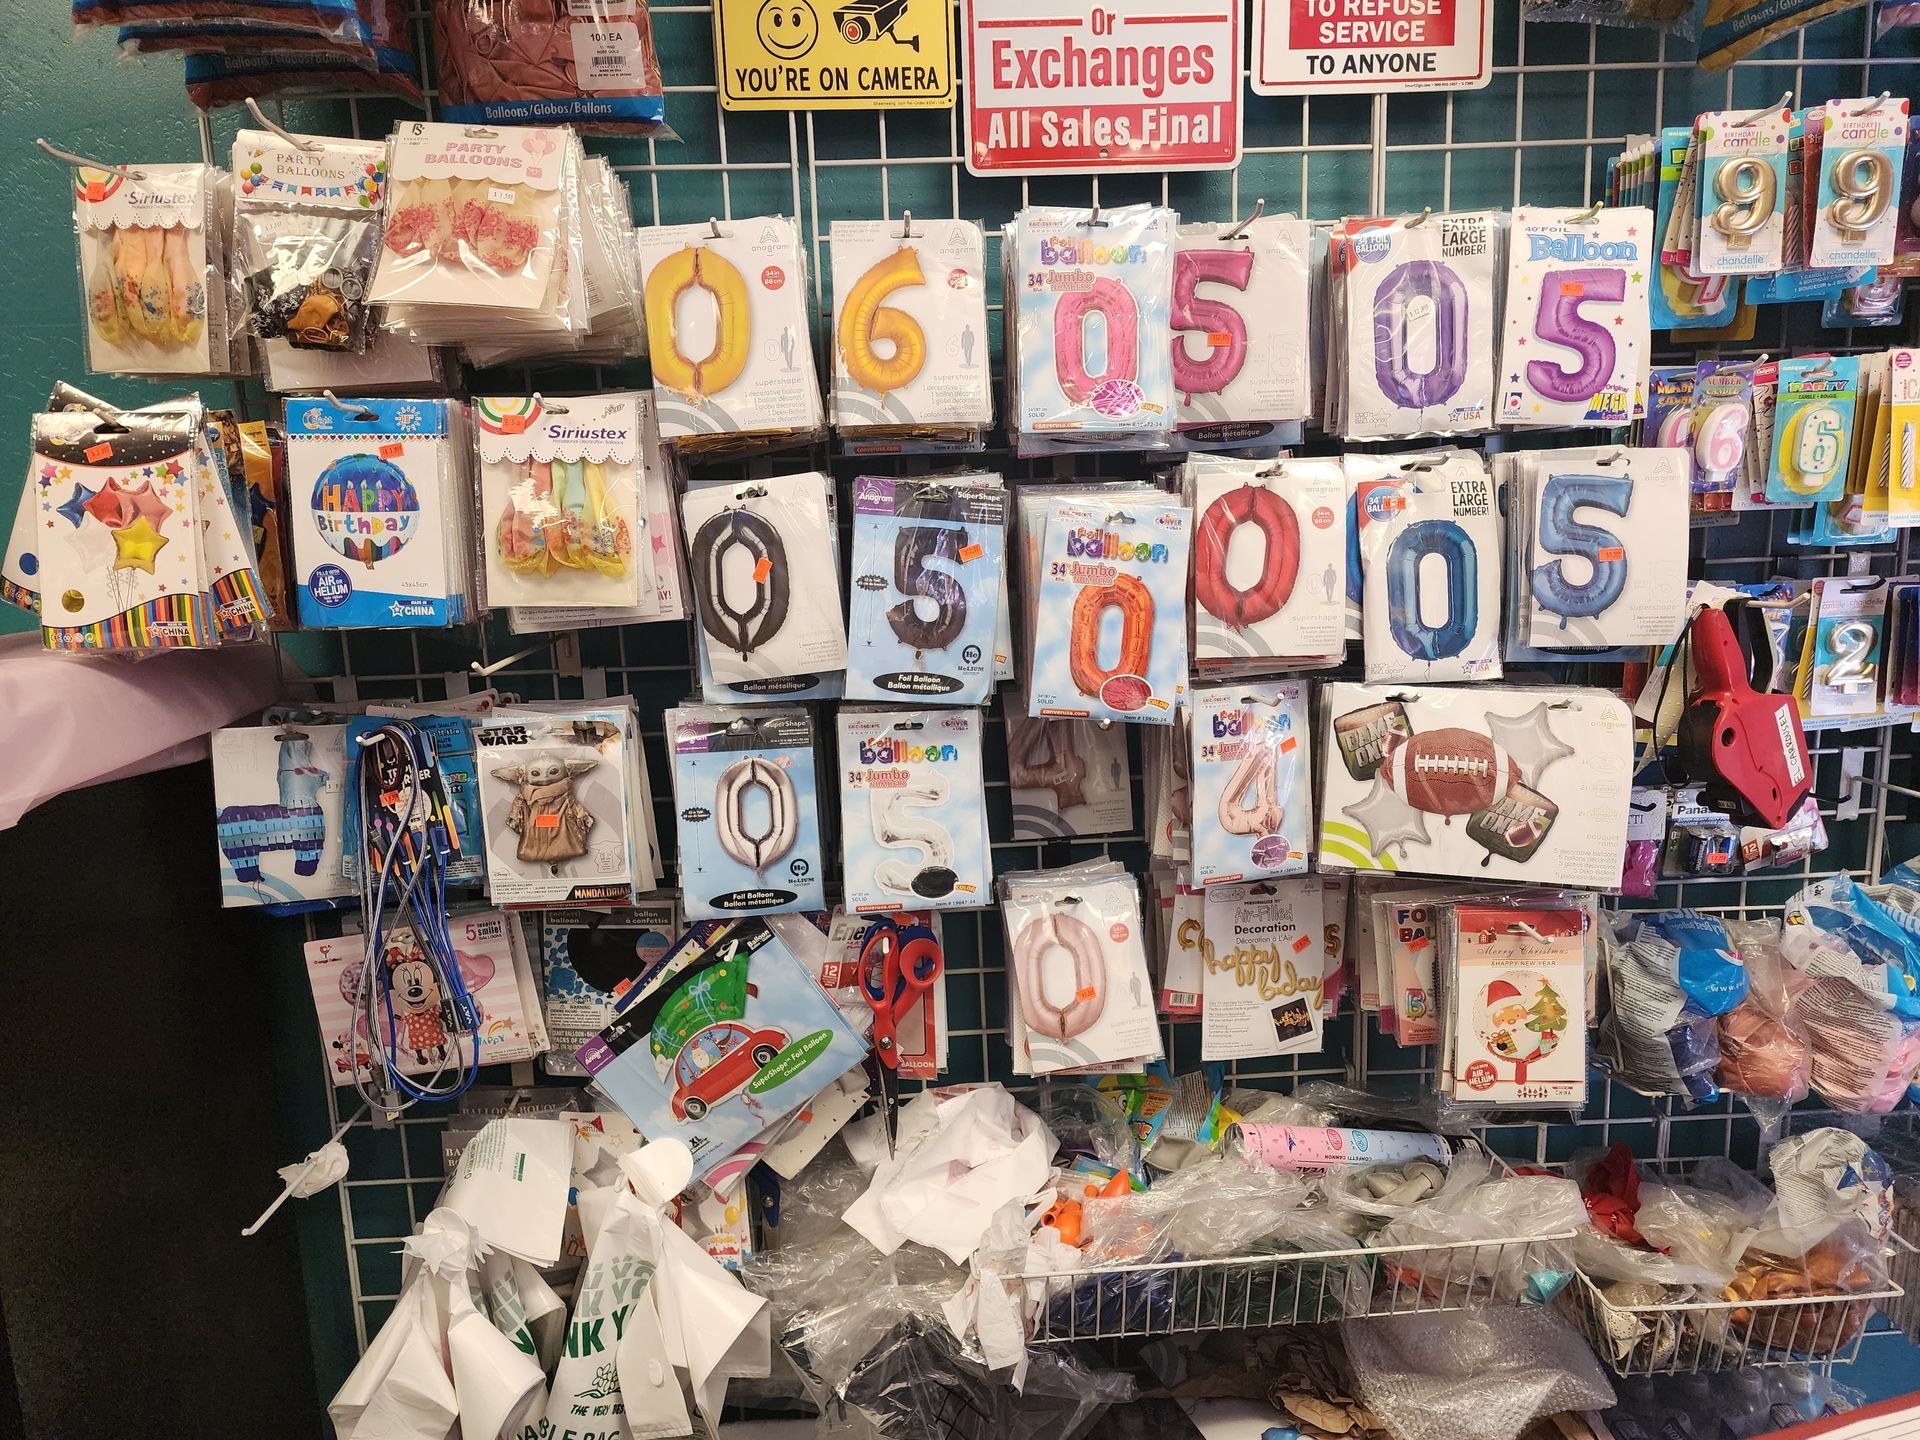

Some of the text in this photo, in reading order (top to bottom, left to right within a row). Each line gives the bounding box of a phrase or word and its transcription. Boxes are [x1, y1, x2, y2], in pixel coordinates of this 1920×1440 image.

[1343, 0, 1442, 16] REFUSE
[1091, 8, 1116, 36] Or
[590, 32, 623, 42] 100 EA
[1319, 20, 1426, 44] SERVICE
[992, 36, 1214, 98] Exchanges
[1306, 52, 1437, 75] TO ANYONE
[735, 65, 940, 92] YOU'RE ON CAMERA
[988, 105, 1221, 149] All Sales Final
[1841, 122, 1889, 140] candle
[445, 142, 506, 154] PARTY
[1723, 134, 1770, 149] candle
[276, 153, 325, 167] PARTY
[424, 153, 523, 169] BALLOONS
[276, 164, 346, 180] BALLOONS
[127, 190, 198, 206] Siriustex
[1710, 157, 1777, 236] 9
[1825, 150, 1894, 232] 9
[1442, 217, 1486, 232] EXTRA
[1371, 234, 1389, 245] FOIL
[1442, 230, 1487, 247] LARGE
[752, 244, 789, 253] anagram
[940, 247, 976, 255] anagram
[1041, 239, 1147, 265] balloon
[1355, 243, 1390, 254] BALLOON
[1442, 245, 1486, 257] NUMBER!
[1527, 233, 1638, 262] Balloon
[1716, 254, 1765, 266] chandelle
[1829, 250, 1877, 262] chandelle
[1047, 269, 1095, 284] Jumbo
[645, 246, 749, 398] 0
[838, 246, 927, 394] 6
[1170, 246, 1254, 395] 5
[1054, 276, 1140, 404] 0
[1374, 259, 1469, 409] 0
[1527, 268, 1626, 403] 5
[755, 378, 802, 387] supershape
[933, 374, 981, 382] supershape
[1250, 377, 1298, 386] supershape
[1707, 376, 1742, 387] NUMBER
[1788, 380, 1850, 392] PARTY
[936, 398, 952, 406] globo
[1590, 392, 1628, 412] MEGA
[1463, 411, 1481, 420] USA
[152, 434, 172, 442] Party
[548, 425, 628, 439] Siriustex
[1198, 427, 1260, 439] Ballon métallique
[1696, 404, 1750, 471] 6
[1799, 408, 1842, 476] 6
[1305, 486, 1341, 495] anagram
[1451, 481, 1487, 493] EXTRA
[322, 484, 408, 513] HAPPY
[859, 493, 894, 505] Anagram
[957, 491, 1001, 502] SuperShape
[1452, 494, 1489, 506] LARGE
[1453, 506, 1490, 517] NUMBER!
[317, 514, 411, 536] Birthday
[1067, 528, 1169, 562] balloon
[1532, 473, 1634, 617] 5
[1195, 486, 1301, 626] 0
[1070, 561, 1117, 577] Jumbo
[318, 576, 336, 587] AIR
[692, 508, 790, 653] 0
[314, 583, 348, 597] HELIUM
[885, 526, 967, 650] 5
[1386, 519, 1478, 661] 0
[231, 602, 256, 617] CHINA
[405, 605, 435, 616] CHINA
[162, 627, 190, 637] CHINA
[1069, 573, 1155, 699] 0
[965, 650, 978, 659] He
[1826, 620, 1879, 686] 2
[1475, 663, 1490, 672] USA
[743, 679, 806, 691] Ballon métallique
[913, 675, 941, 683] Balloon
[888, 682, 950, 692] Ballon métallique
[1148, 698, 1170, 710] COLOR
[1042, 708, 1088, 717] converusa.com
[1344, 711, 1396, 752] GAME
[1591, 720, 1626, 729] anagram
[478, 726, 527, 738] STAR
[477, 735, 531, 747] WARS
[1218, 739, 1254, 754] Jumbo
[860, 739, 958, 765] balloon
[865, 767, 910, 782] Jumbo
[1218, 742, 1284, 838] 4
[715, 757, 799, 868] 0
[870, 772, 954, 896] 5
[1586, 832, 1620, 843] bouquet
[1559, 849, 1618, 858] decorative balloons
[1743, 843, 1757, 855] 12
[1564, 855, 1590, 863] ballons
[1564, 862, 1585, 870] globos
[1205, 874, 1242, 884] converusa.com
[574, 887, 631, 900] MANDALORIAN
[955, 884, 977, 893] COLOR
[724, 897, 785, 908] Ballon métallique
[858, 903, 901, 912] converusa.com
[632, 916, 669, 925] confettis
[1234, 904, 1294, 924] Air-Filled
[466, 924, 477, 941] 5
[477, 925, 502, 937] smile!
[1234, 922, 1296, 935] Decoration
[747, 930, 770, 948] Balloon
[1235, 936, 1271, 945] Décoration
[1477, 944, 1569, 959] Merry Christmas
[824, 965, 838, 976] 12
[1014, 914, 1107, 1039] 0
[791, 1033, 828, 1062] Foil Balloon
[585, 1046, 609, 1066] Anagram
[784, 1059, 807, 1077] Christmas
[901, 1061, 935, 1069] BALLOON
[1472, 1068, 1484, 1078] AIR
[1469, 1075, 1495, 1086] HELIUM
[689, 1135, 701, 1147] XL
[570, 1404, 610, 1416] THE VERY
